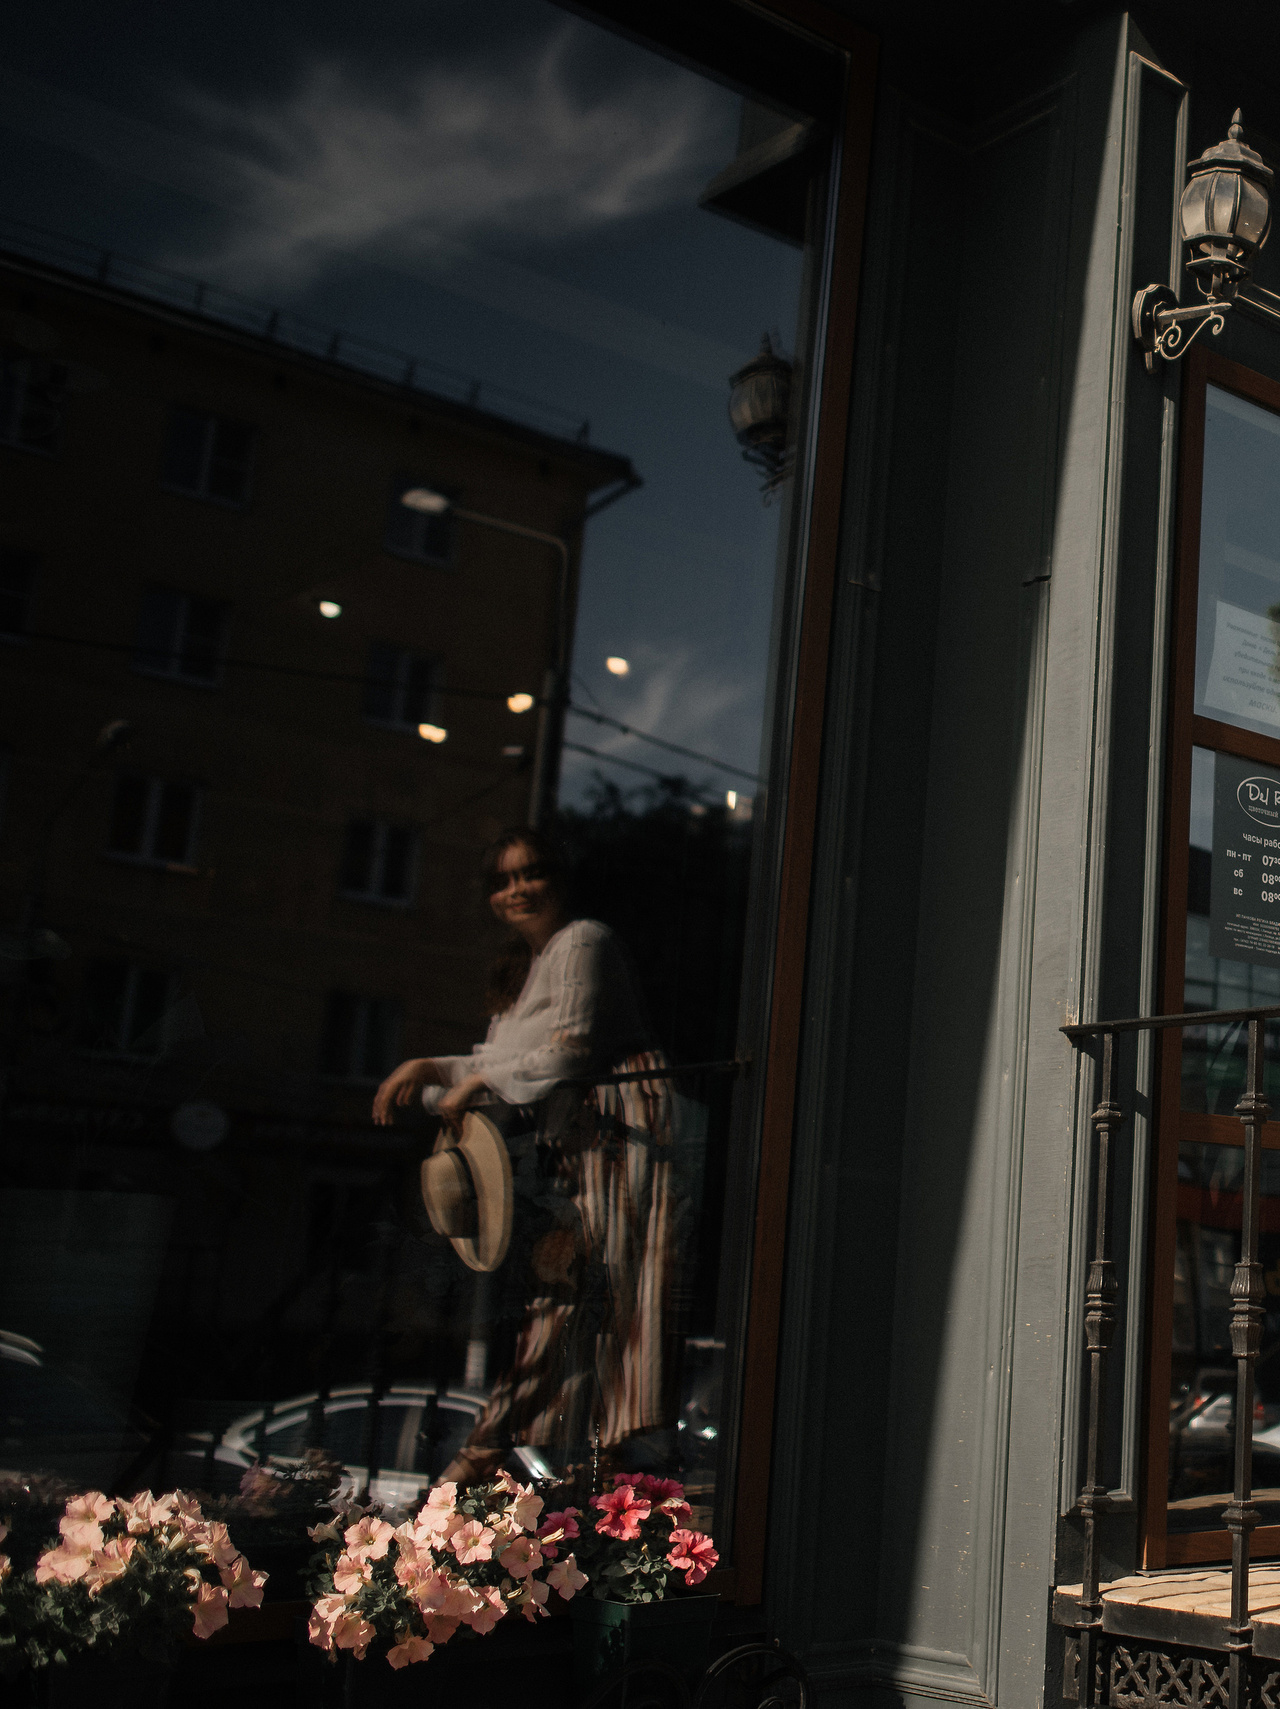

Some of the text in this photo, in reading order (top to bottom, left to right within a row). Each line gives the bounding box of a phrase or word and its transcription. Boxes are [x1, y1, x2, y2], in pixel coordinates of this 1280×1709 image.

[1246, 783, 1269, 806] Del
[1243, 833, 1262, 845] часы
[1226, 849, 1236, 858] пн
[1242, 853, 1252, 861] пт
[1233, 869, 1244, 878] сб
[1233, 887, 1243, 896] вс
